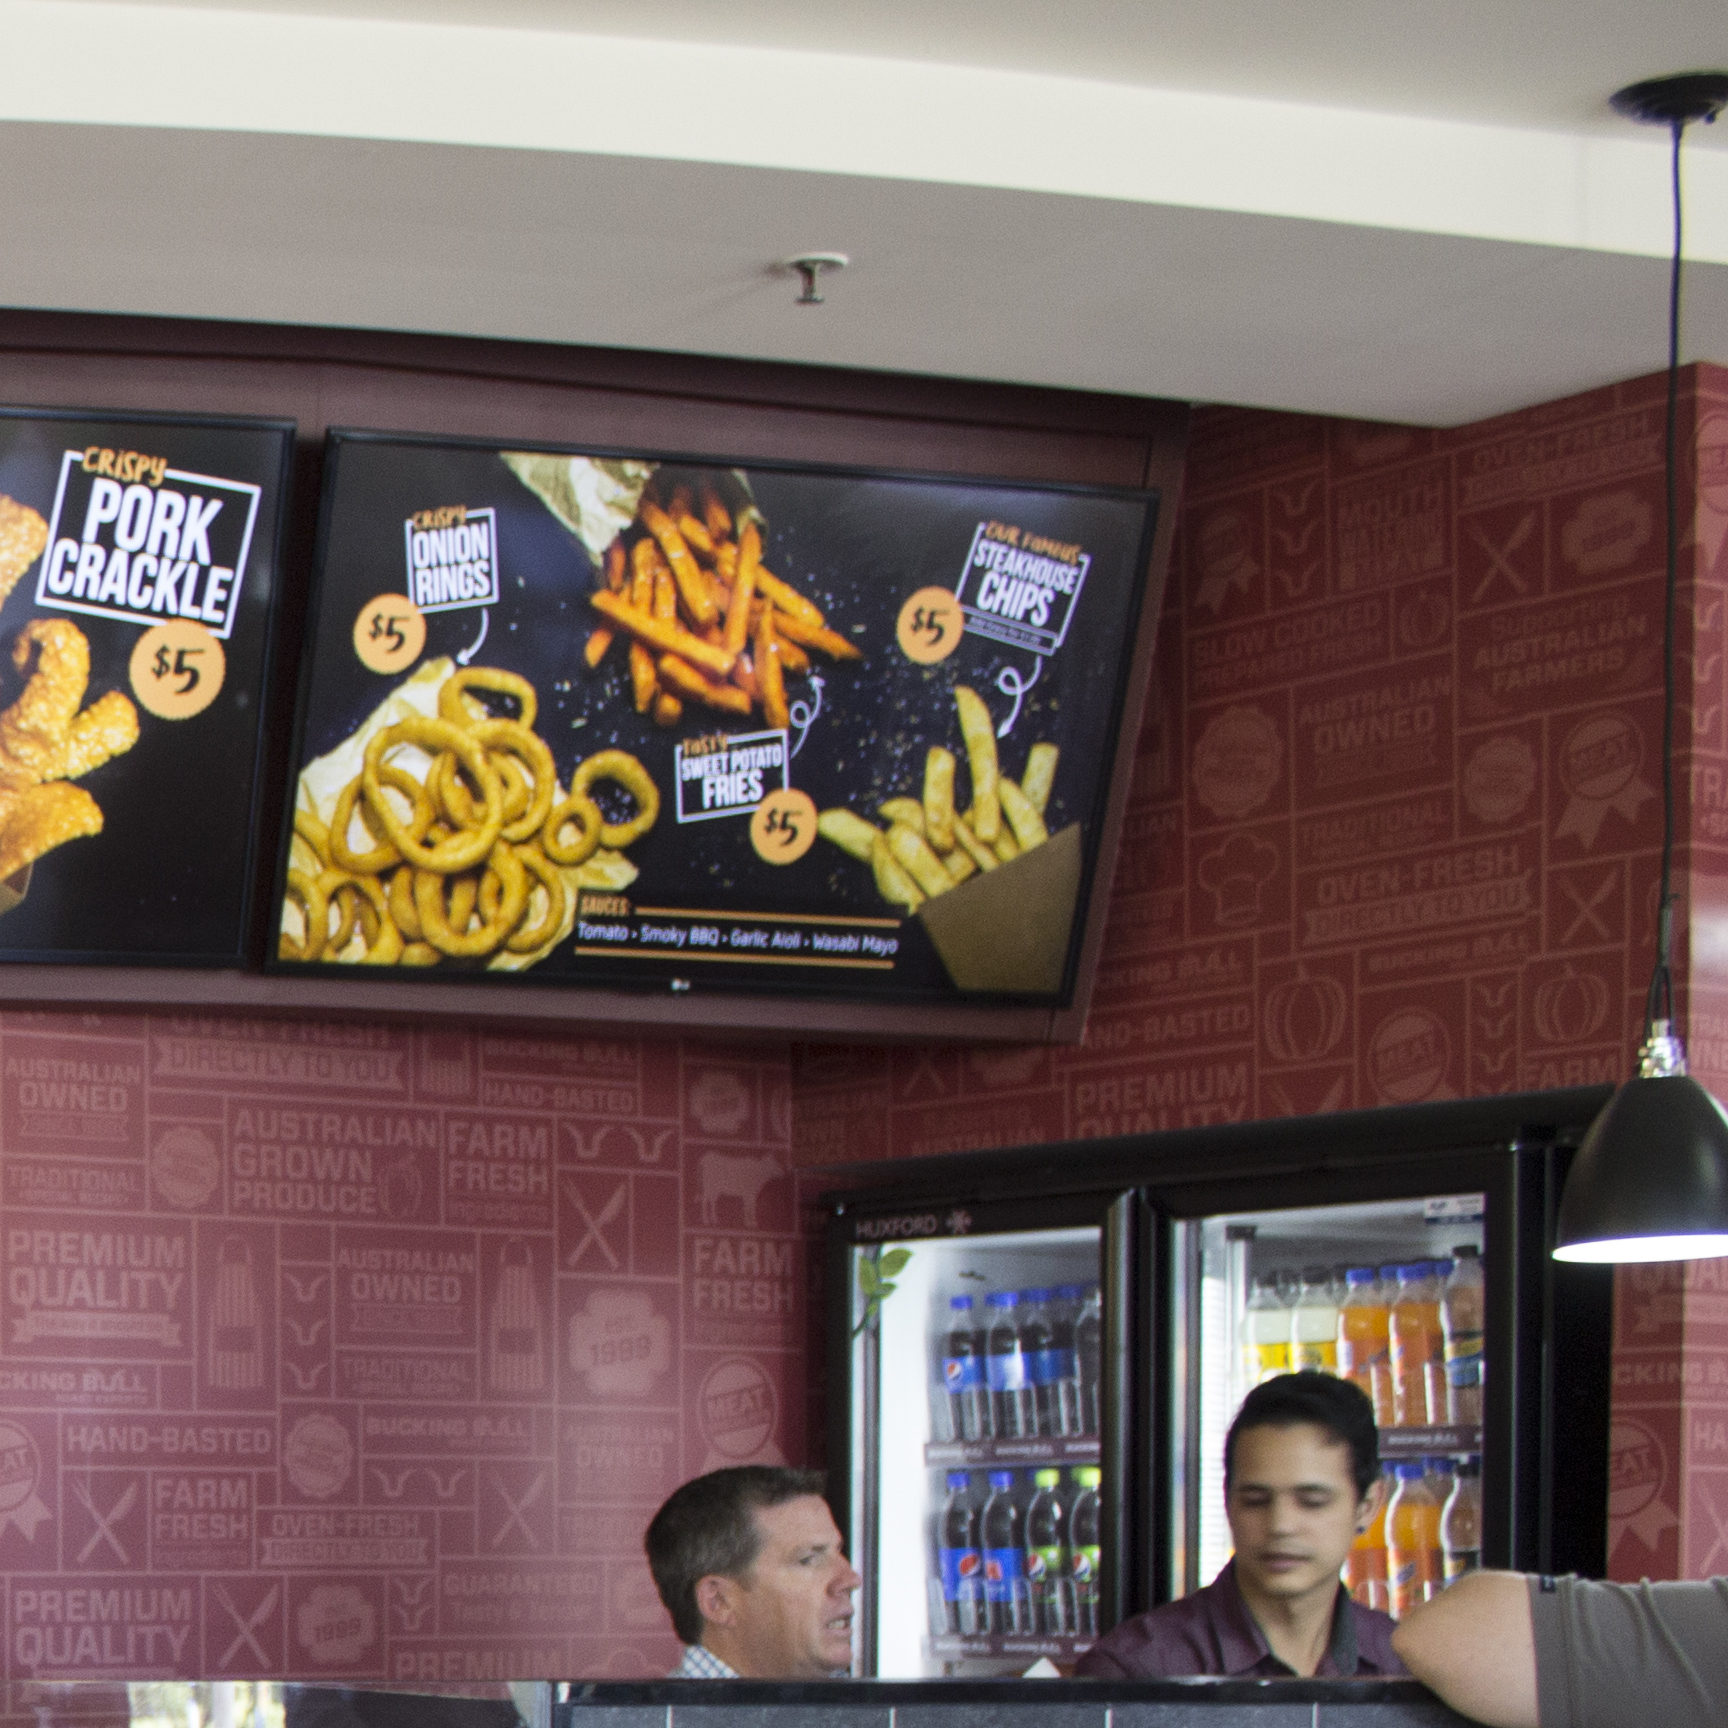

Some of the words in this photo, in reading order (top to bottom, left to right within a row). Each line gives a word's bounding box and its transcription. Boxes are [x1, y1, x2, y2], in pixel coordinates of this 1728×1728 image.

[82, 477, 223, 566] PORK
[413, 522, 489, 569] ONION
[48, 538, 234, 623] CRACKLE
[416, 560, 491, 606] RINGS
[974, 539, 1080, 594] STEAKHOUSE
[977, 571, 1055, 627] CHIPS
[369, 612, 410, 653] $5
[911, 607, 949, 646] $5
[151, 644, 206, 695] $5
[682, 752, 728, 781] SWEET
[730, 744, 783, 773] POTATO
[702, 768, 764, 809] FRIES
[765, 808, 802, 847] $5
[577, 921, 629, 942] Tomato
[640, 923, 687, 946] Smoky
[690, 926, 719, 946] BBQ
[730, 928, 768, 948] Garlic
[5, 1058, 141, 1085] AUSTRALIAN
[19, 1080, 129, 1112] OWNED
[234, 1108, 437, 1149] AUSTRALIAN
[448, 1122, 547, 1160] FARM
[233, 1144, 372, 1183] GROWN
[449, 1160, 547, 1195] FRESH
[233, 1182, 376, 1214] PRODUCE
[856, 1215, 937, 1238] HUXFORD
[8, 1229, 185, 1269] PREMIUM
[9, 1267, 185, 1313] QUALITY
[66, 1426, 272, 1454] HAND-BASTED
[14, 1589, 193, 1623] PREMIUM
[15, 1625, 191, 1667] QUALITY
